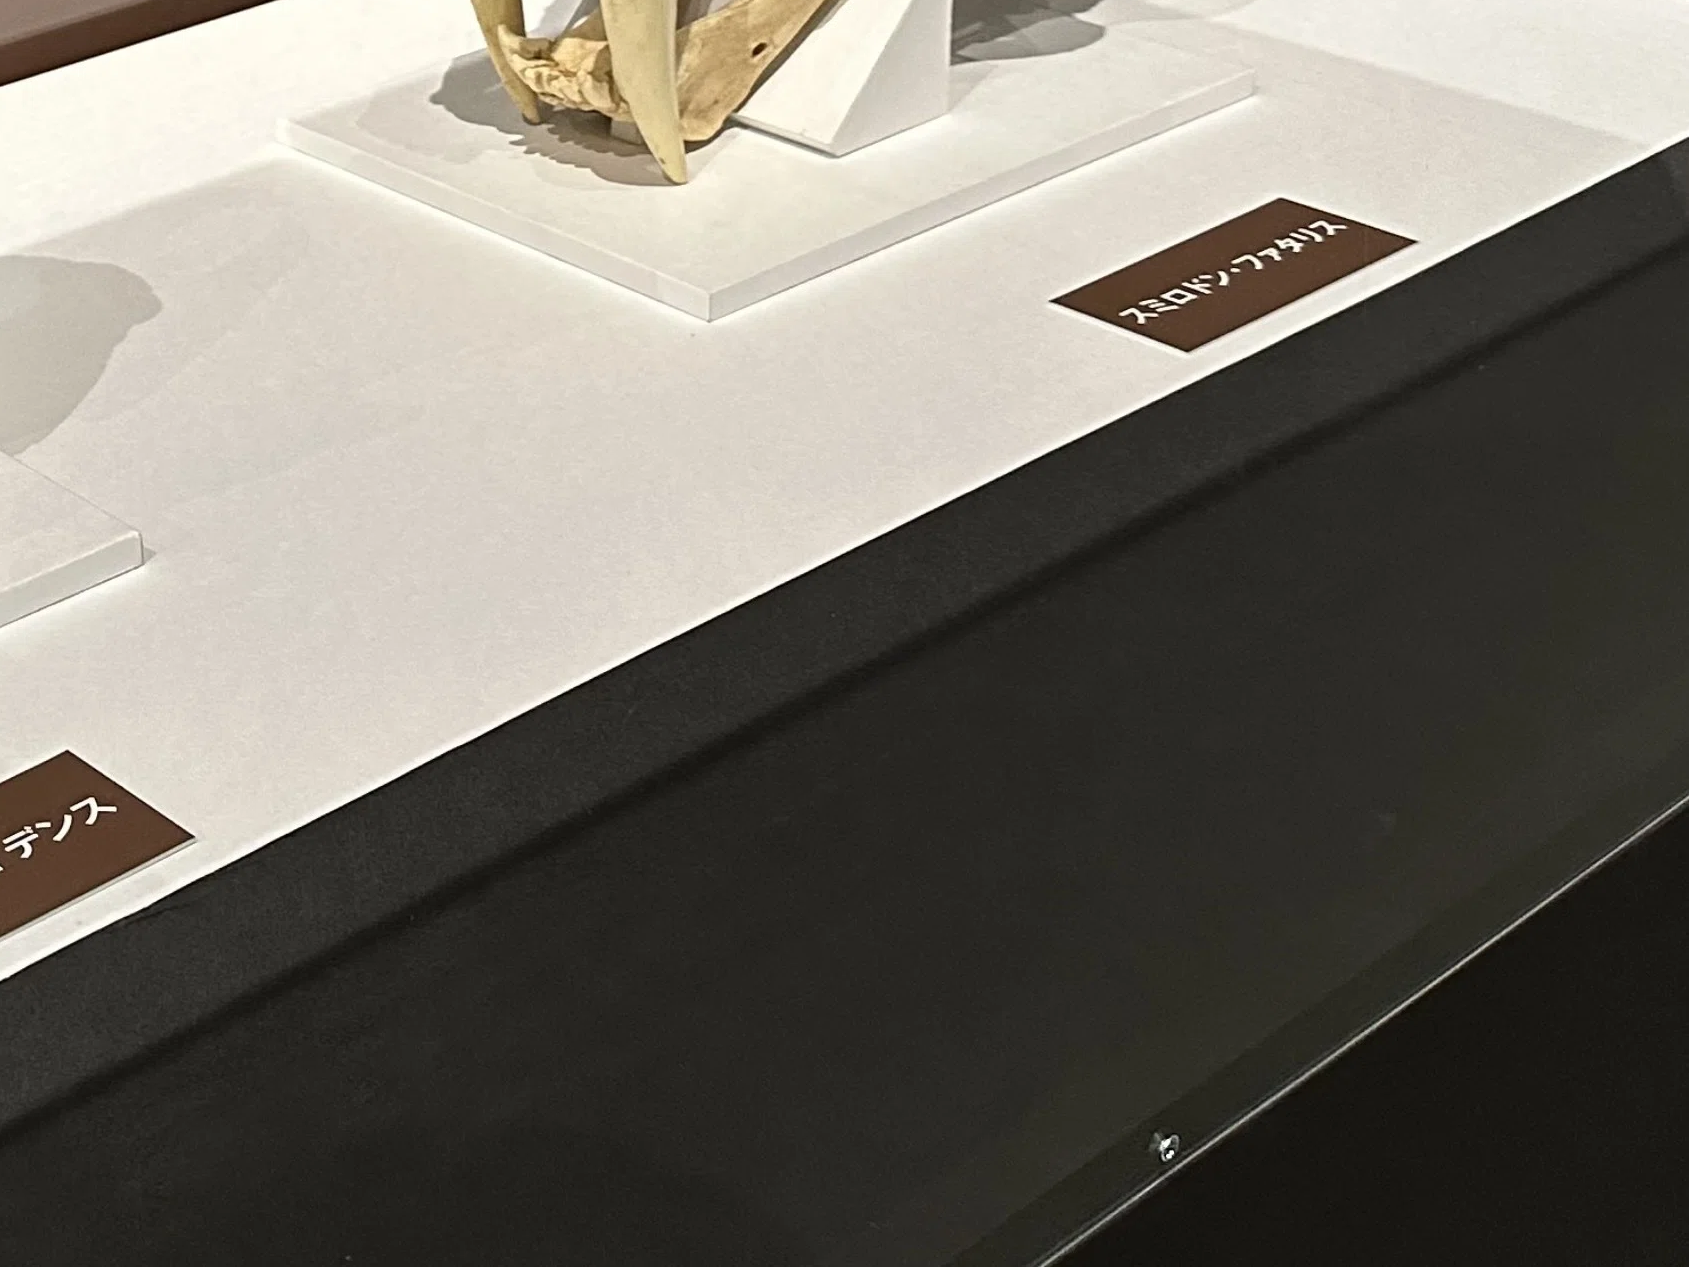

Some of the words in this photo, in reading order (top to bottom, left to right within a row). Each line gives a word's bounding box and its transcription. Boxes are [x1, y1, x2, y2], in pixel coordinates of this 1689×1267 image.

[1118, 219, 1348, 325] スミロドン・ファタリス
